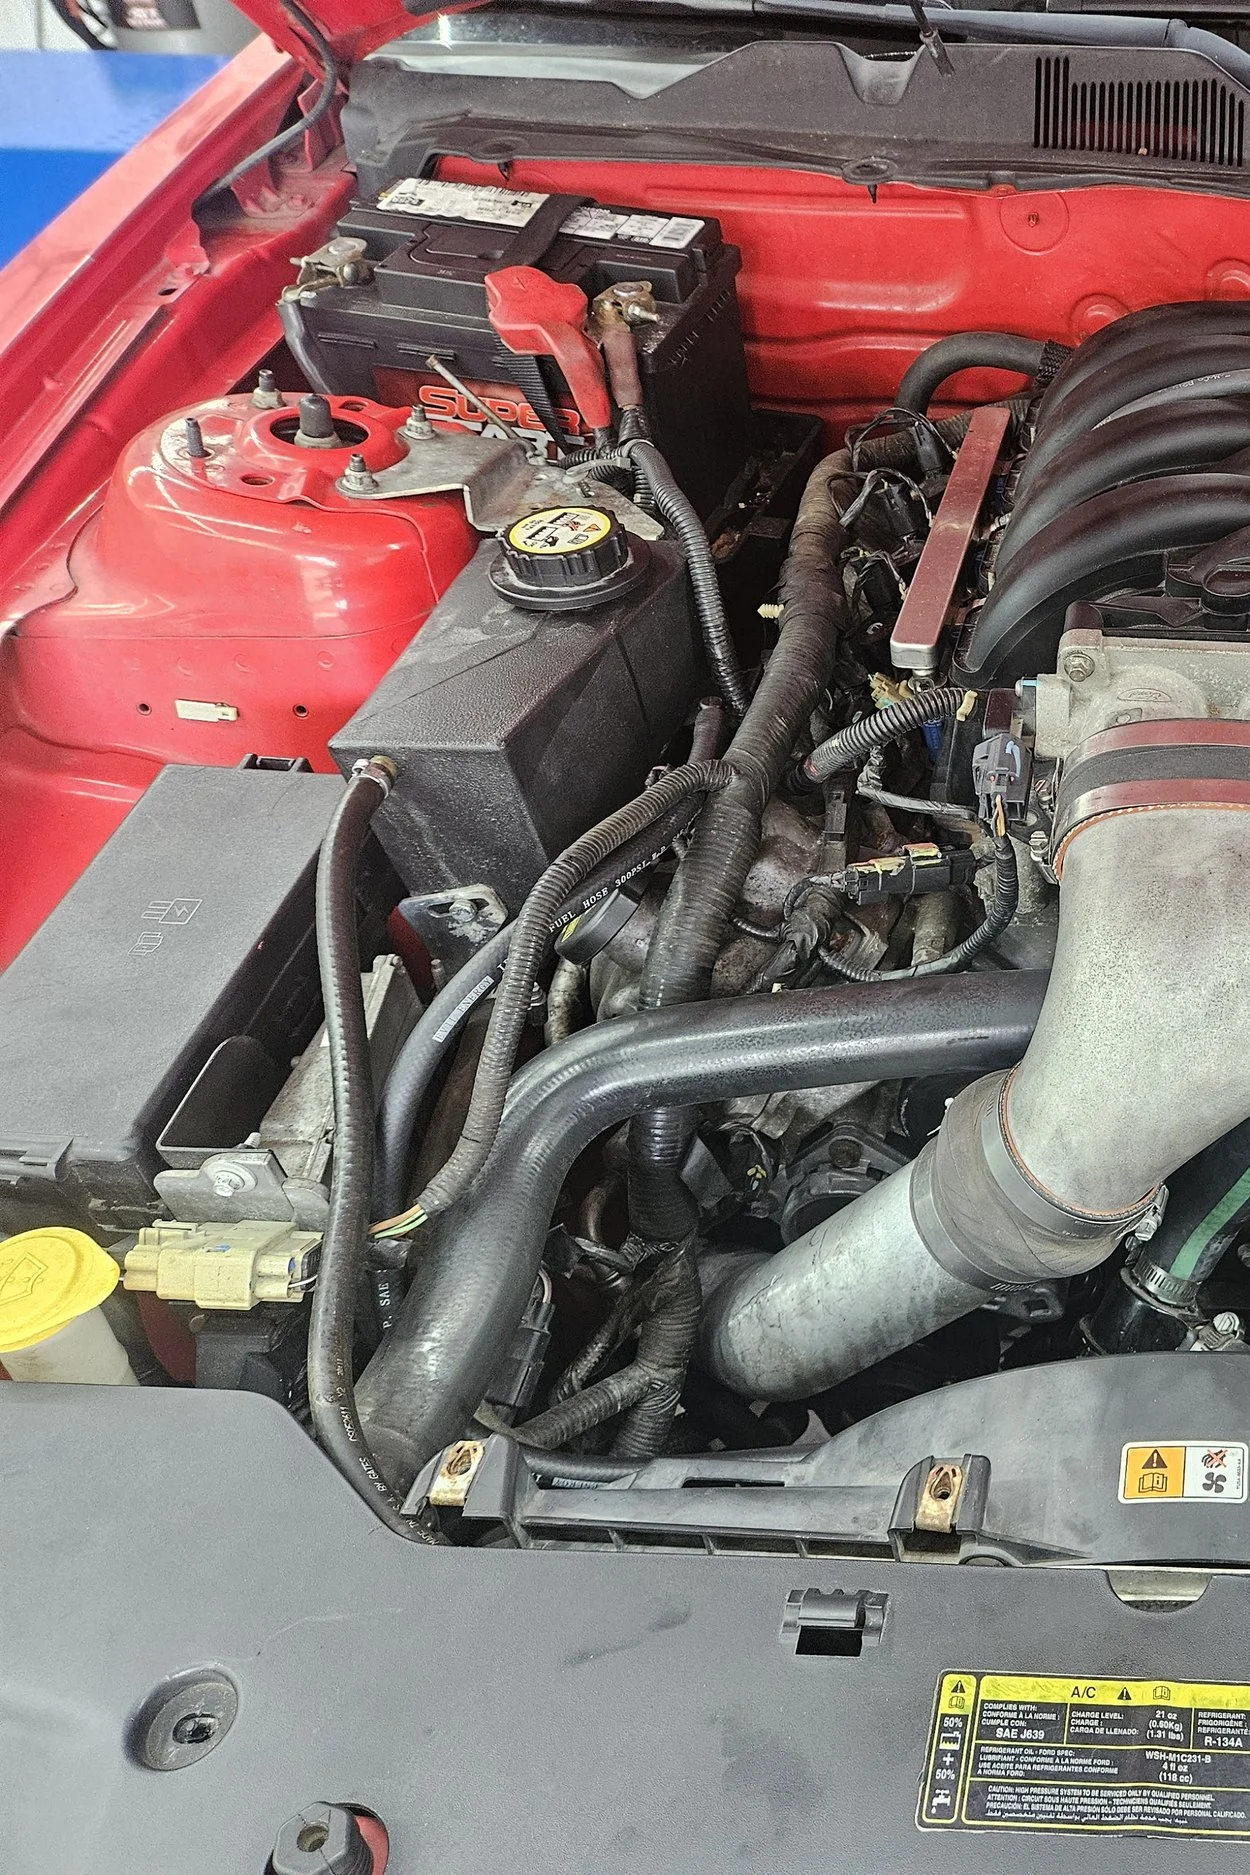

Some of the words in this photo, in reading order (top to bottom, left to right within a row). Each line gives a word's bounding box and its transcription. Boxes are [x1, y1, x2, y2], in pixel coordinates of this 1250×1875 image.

[419, 385, 580, 436] SUPER
[549, 910, 576, 933] FUEL
[582, 887, 609, 910] HOSE
[435, 1011, 460, 1040] EVIL
[458, 978, 492, 1015] ENERGY
[379, 1282, 390, 1306] SAE
[358, 1456, 381, 1481] GATES
[373, 1480, 387, 1493] BY
[1070, 1686, 1096, 1698] A/C
[983, 1711, 1017, 1719] CONFORME
[1155, 1710, 1165, 1718] 21
[943, 1717, 963, 1728] 50%
[1149, 1720, 1183, 1732] (0.60Kg)
[996, 1728, 1017, 1739] SAE
[1020, 1729, 1044, 1739] J639
[1146, 1729, 1166, 1739] (1.31
[1168, 1731, 1184, 1741] lbs)
[1204, 1736, 1243, 1747] R-134A
[981, 1746, 1023, 1754] REFRIGERANT
[1145, 1751, 1211, 1763] WSH-M1C231-B
[1084, 1766, 1118, 1774] CONFORME
[1162, 1762, 1168, 1770] 4
[1170, 1763, 1176, 1771] fl
[1178, 1764, 1188, 1772] oz
[936, 1768, 955, 1780] 50%
[1159, 1772, 1177, 1782] (118
[1179, 1774, 1192, 1784] cc)
[988, 1785, 1014, 1793] CAUTION:
[1030, 1787, 1059, 1795] PRESSURE
[1151, 1791, 1180, 1799] QUALIFIED
[1181, 1793, 1215, 1801] PERSONNEL.
[1080, 1797, 1108, 1805] PRESSION
[1113, 1798, 1148, 1806] TECHNICIENS
[1183, 1809, 1212, 1817] PERSONAL
